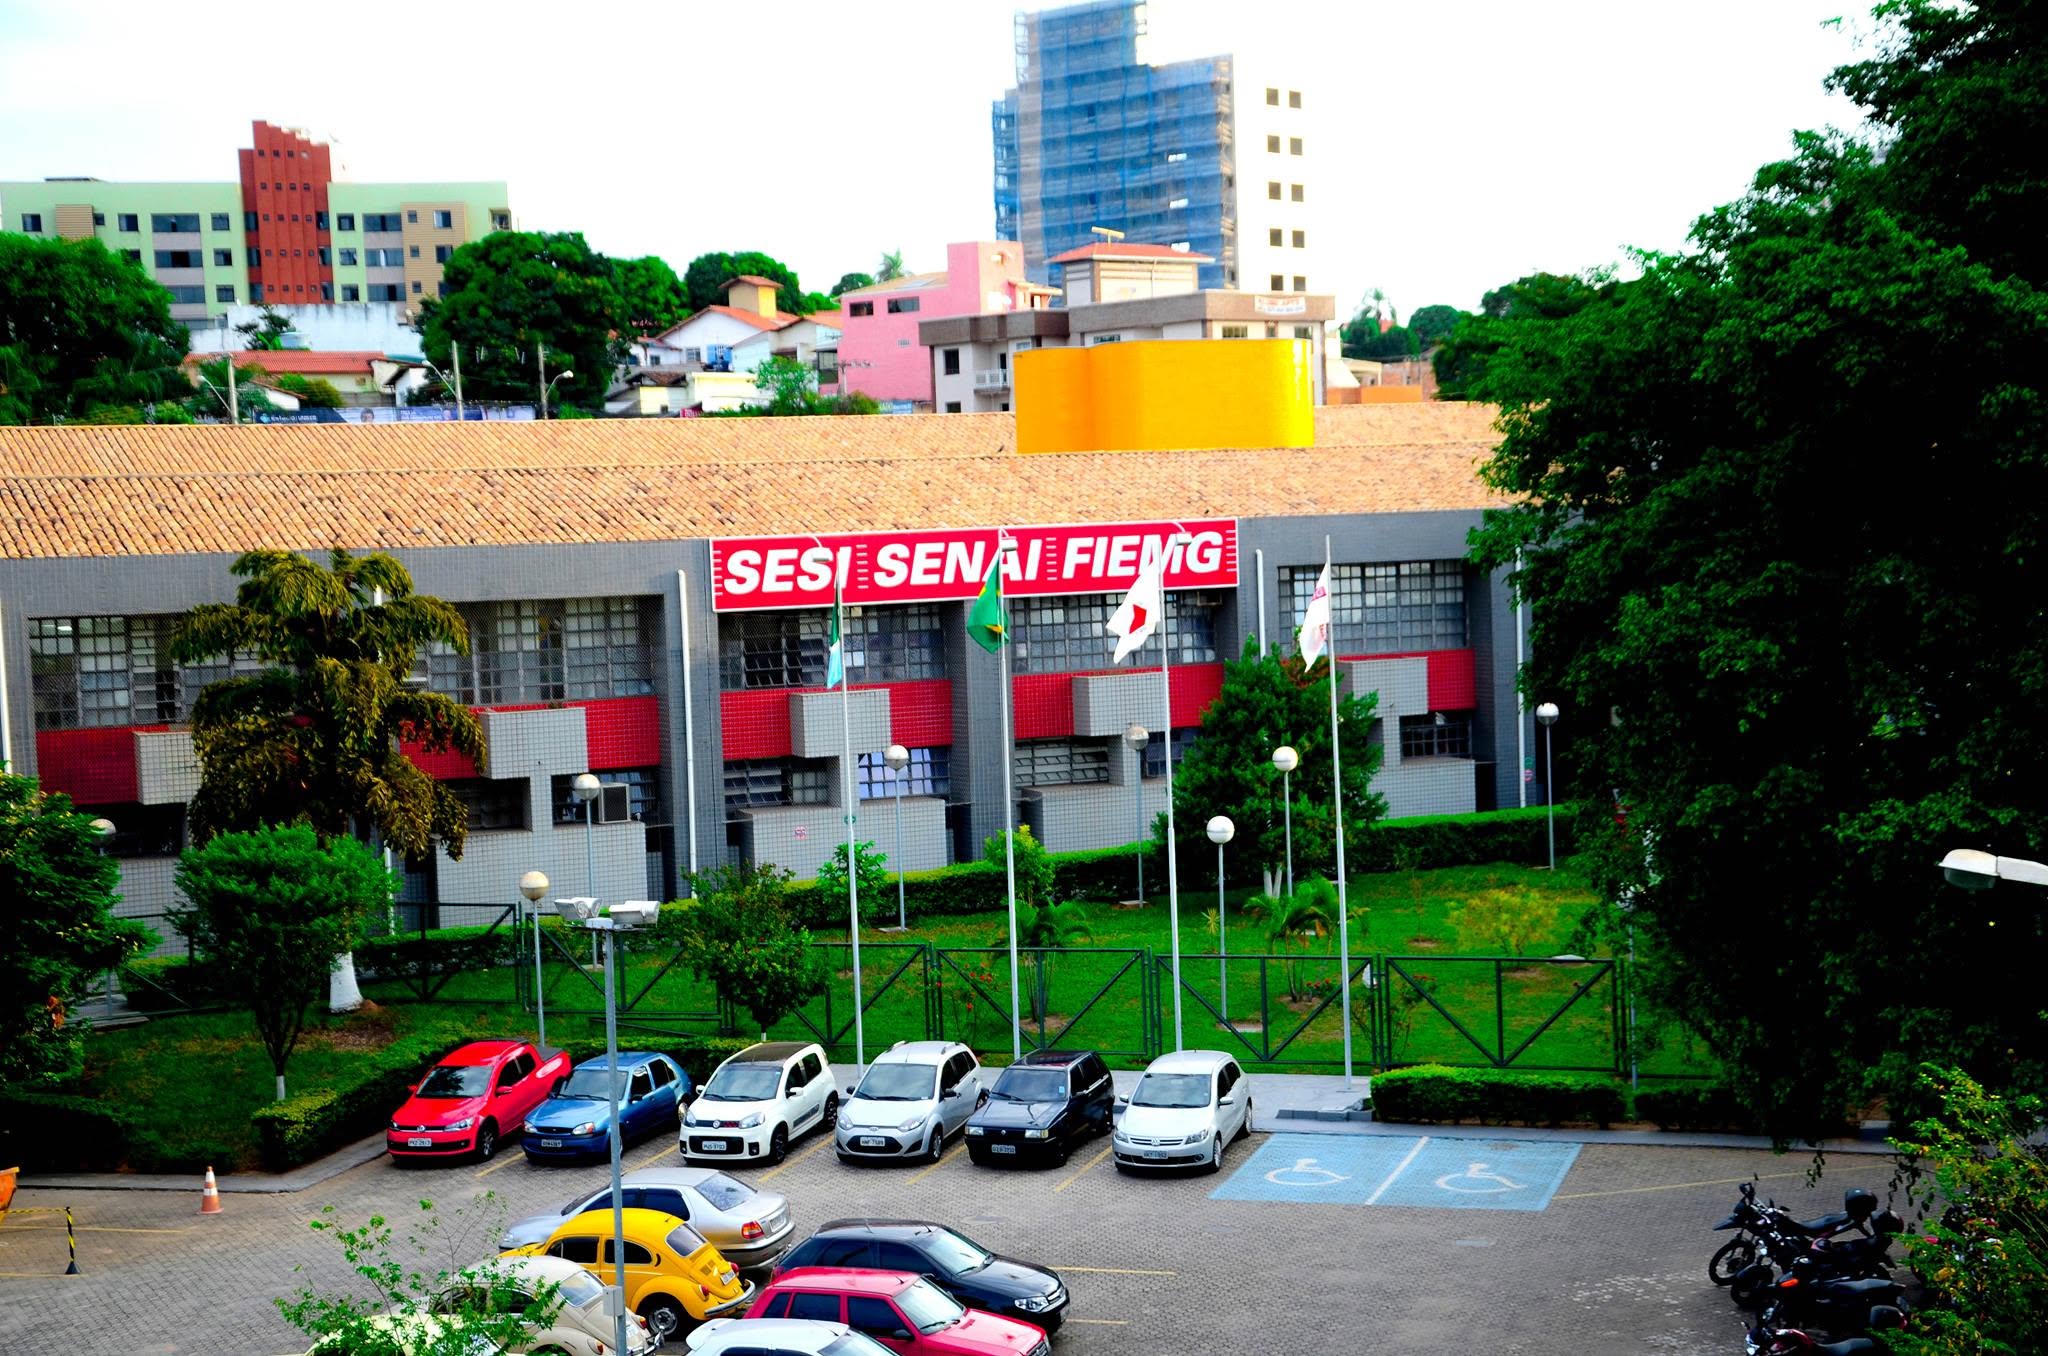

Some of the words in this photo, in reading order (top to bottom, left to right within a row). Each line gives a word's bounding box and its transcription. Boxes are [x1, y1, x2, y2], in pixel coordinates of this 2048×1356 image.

[724, 546, 852, 595] SESI
[873, 539, 1042, 588] SENAI
[1062, 531, 1223, 579] FIEMG
